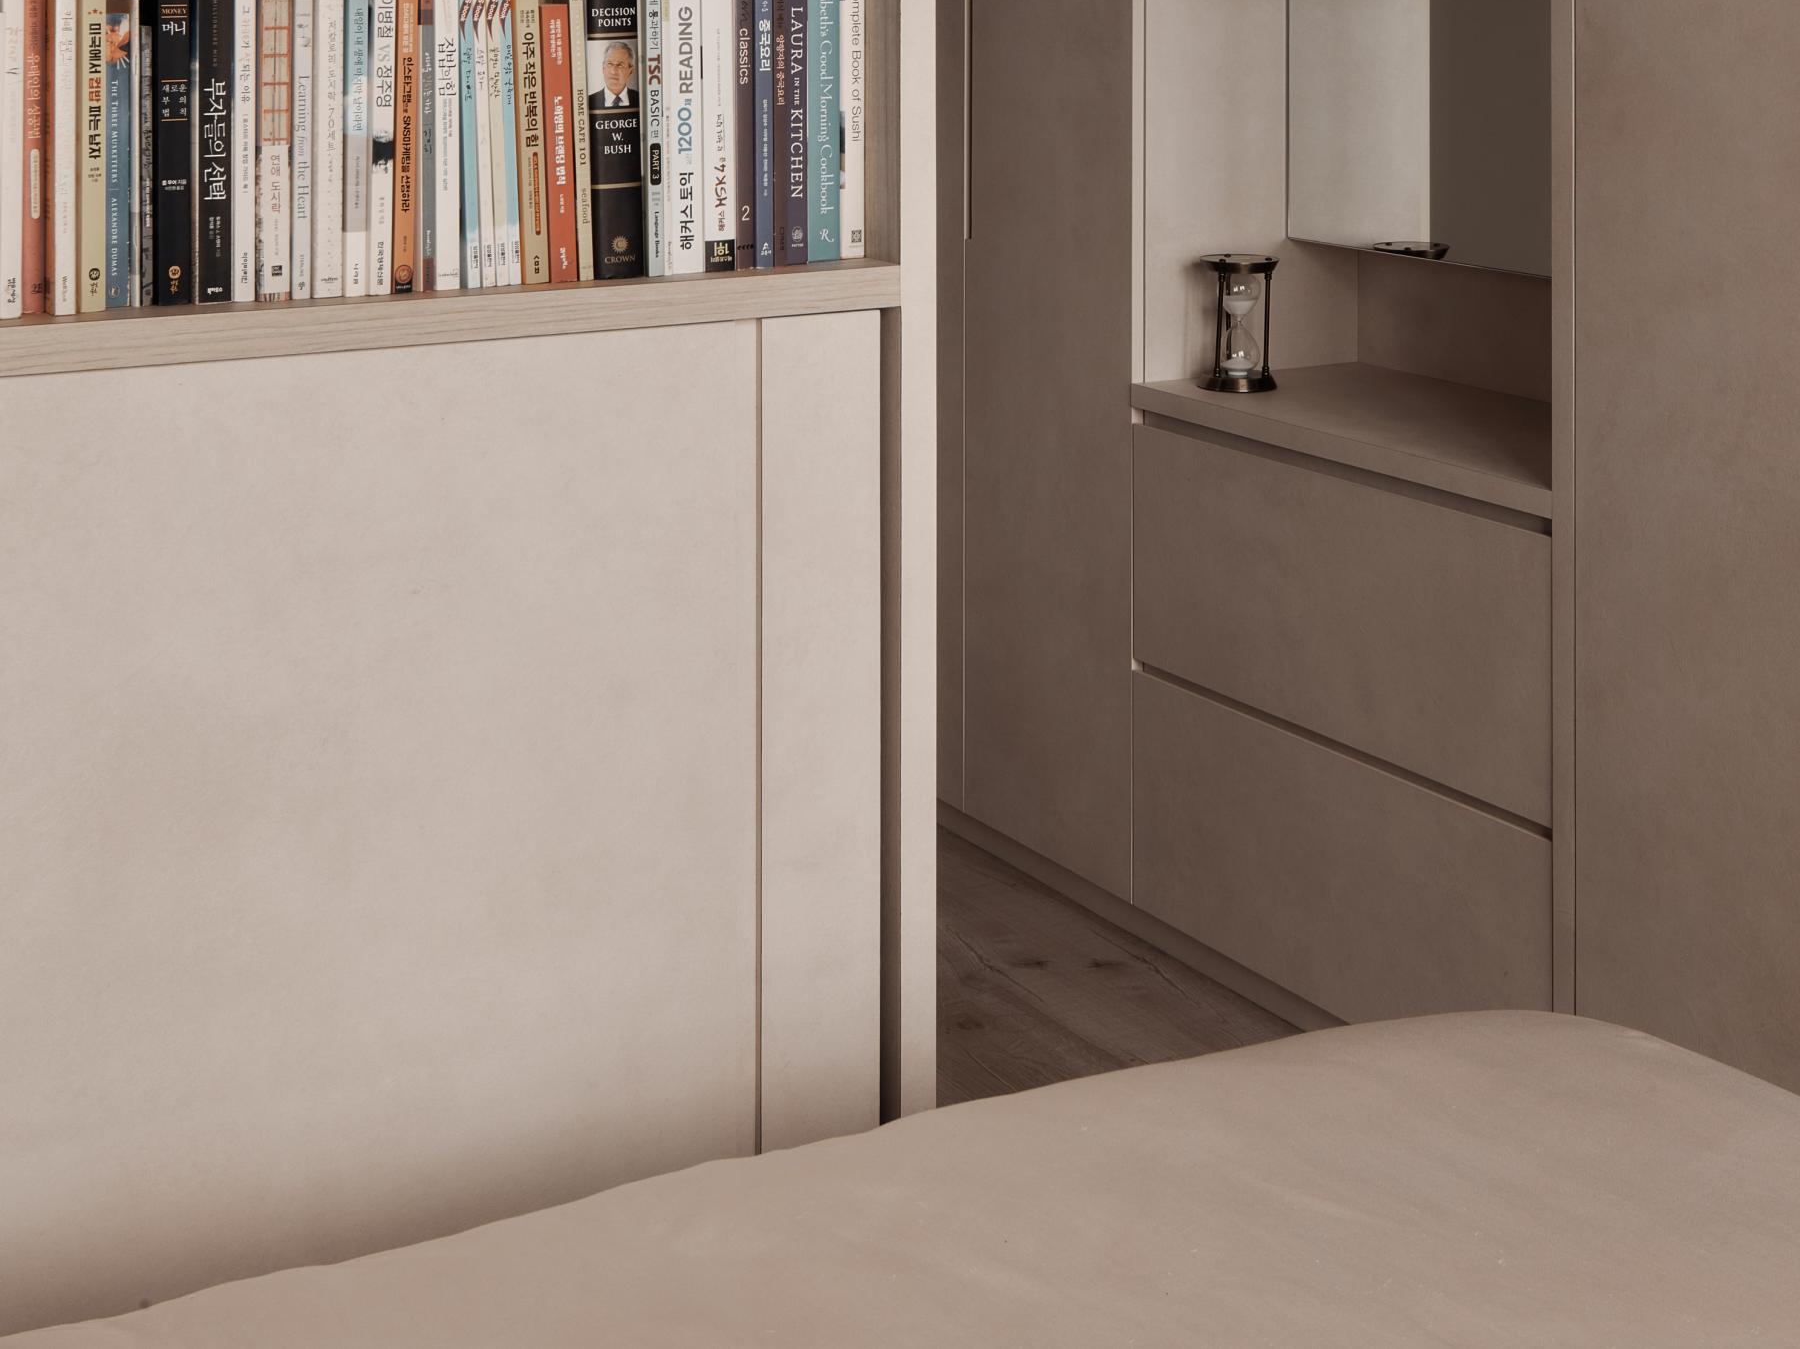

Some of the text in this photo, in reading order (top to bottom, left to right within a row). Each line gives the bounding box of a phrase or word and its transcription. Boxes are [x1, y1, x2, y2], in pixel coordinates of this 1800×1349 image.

[162, 20, 186, 36] 머니
[591, 7, 636, 17] DECISION
[597, 18, 632, 27] POINTS
[648, 9, 661, 50] 통과하기
[377, 44, 391, 62] VS
[522, 32, 535, 60] 아주
[739, 27, 751, 85] classics
[758, 18, 771, 72] 중국요리
[819, 40, 834, 80] Good
[27, 52, 41, 101] 유태인의
[376, 64, 393, 107] 정주영
[523, 61, 536, 90] 작은
[647, 54, 661, 85] TSC
[850, 50, 862, 87] Book
[88, 23, 102, 160] 미국에서 컵밥 파는 남자
[438, 81, 457, 96] 힘
[790, 7, 804, 199] LAURA IN THE KITCHEN
[851, 89, 862, 103] of
[27, 104, 41, 139] 성공법
[525, 91, 538, 131] 반복의
[595, 118, 638, 130] GEORGE
[650, 89, 661, 128] BASIC
[818, 83, 834, 142] Morning
[850, 105, 862, 142] Sushi
[203, 78, 227, 200] 부자들의 선택
[526, 134, 539, 147] 힘
[611, 132, 624, 141] W.
[678, 6, 695, 250] 해커스 토익 READING
[295, 75, 310, 219] Learning the Heart
[579, 147, 587, 166] 101
[604, 144, 632, 155] BUSH
[652, 149, 660, 170] PART
[714, 176, 727, 208] HSK
[819, 144, 834, 215] Cookbook
[581, 188, 590, 225] seafood
[741, 205, 750, 221] 2
[604, 254, 635, 264] CROWN
